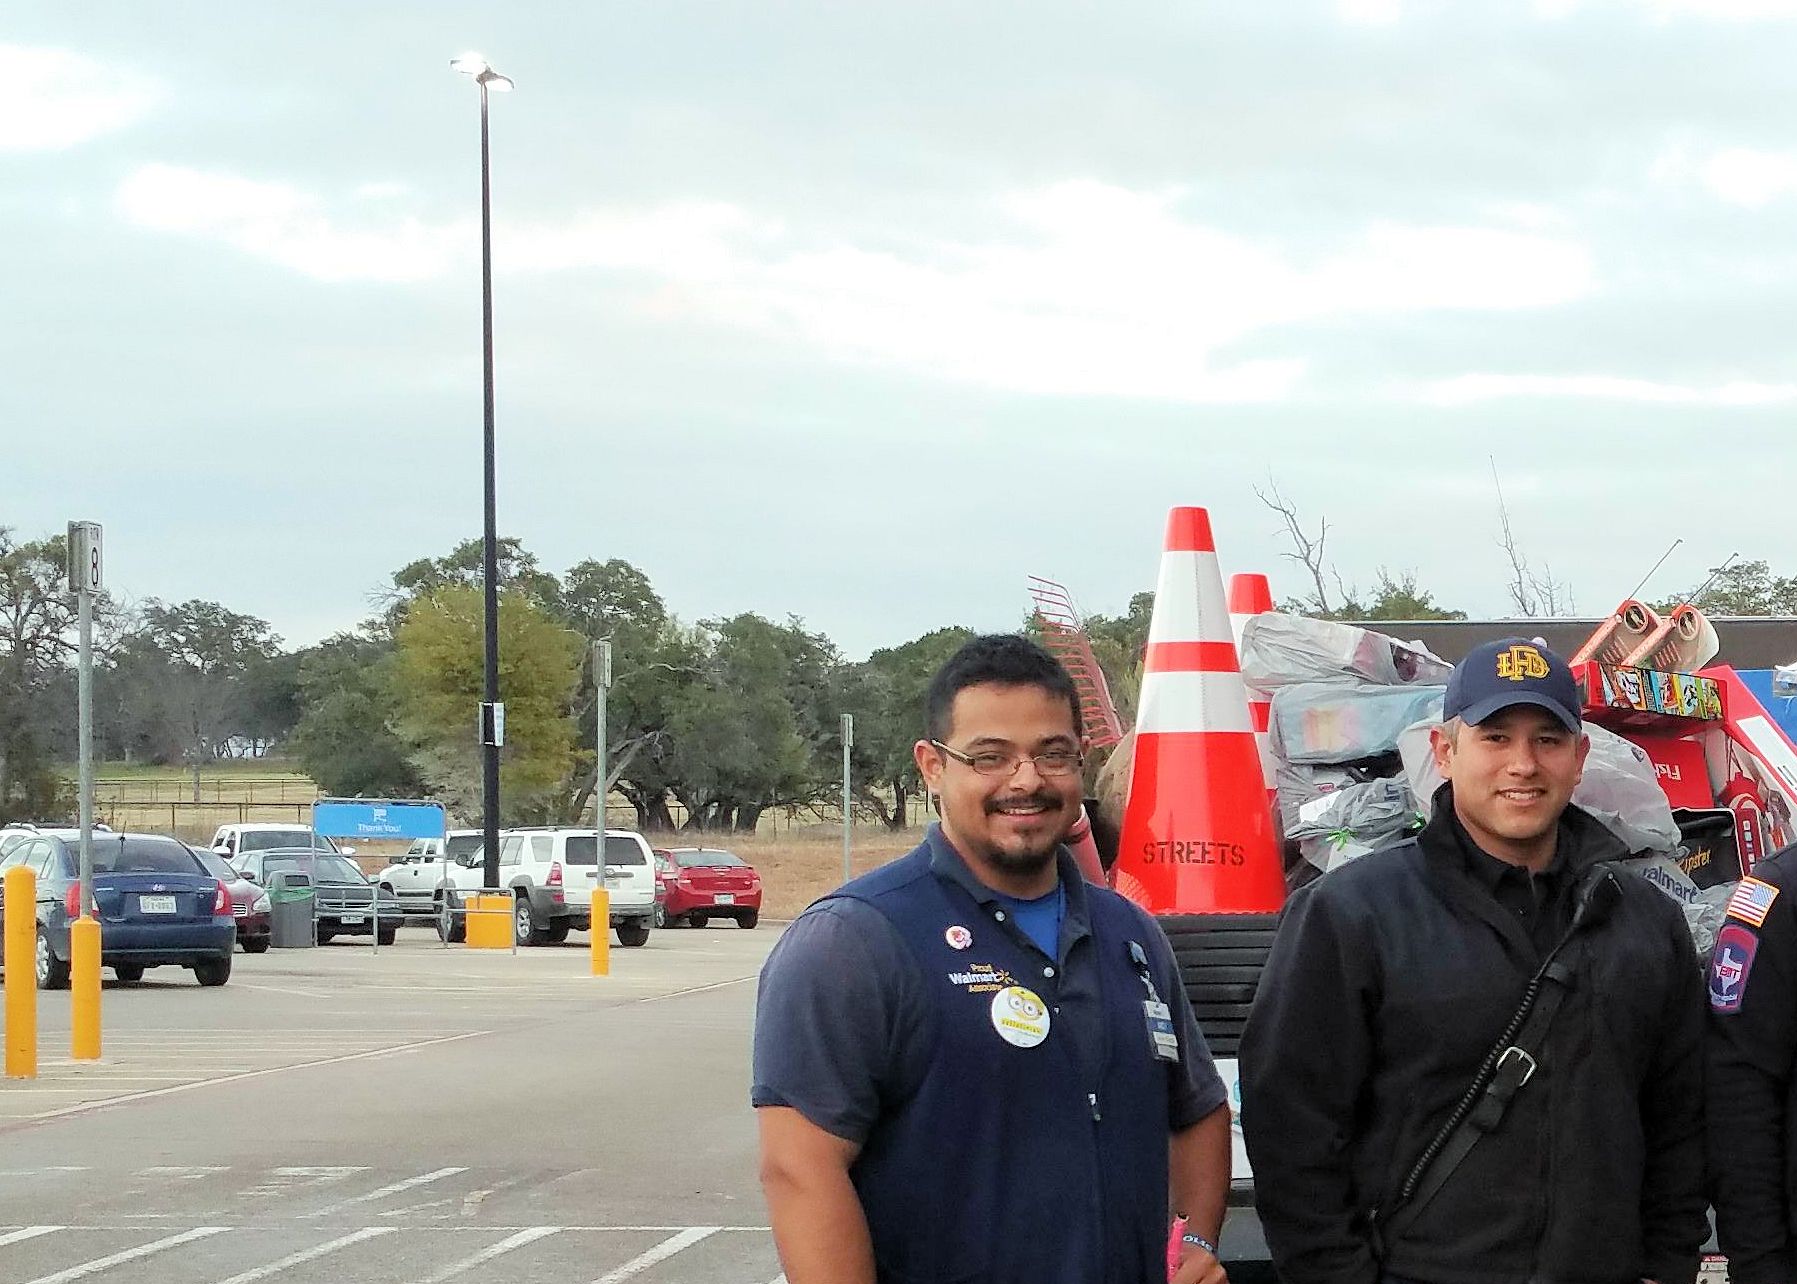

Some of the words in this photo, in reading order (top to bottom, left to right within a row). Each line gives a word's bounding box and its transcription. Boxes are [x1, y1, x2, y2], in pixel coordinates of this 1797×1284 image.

[358, 823, 382, 833] Thank
[382, 823, 402, 833] You!
[1143, 841, 1244, 866] STREETS
[948, 971, 1001, 985] Walmart
